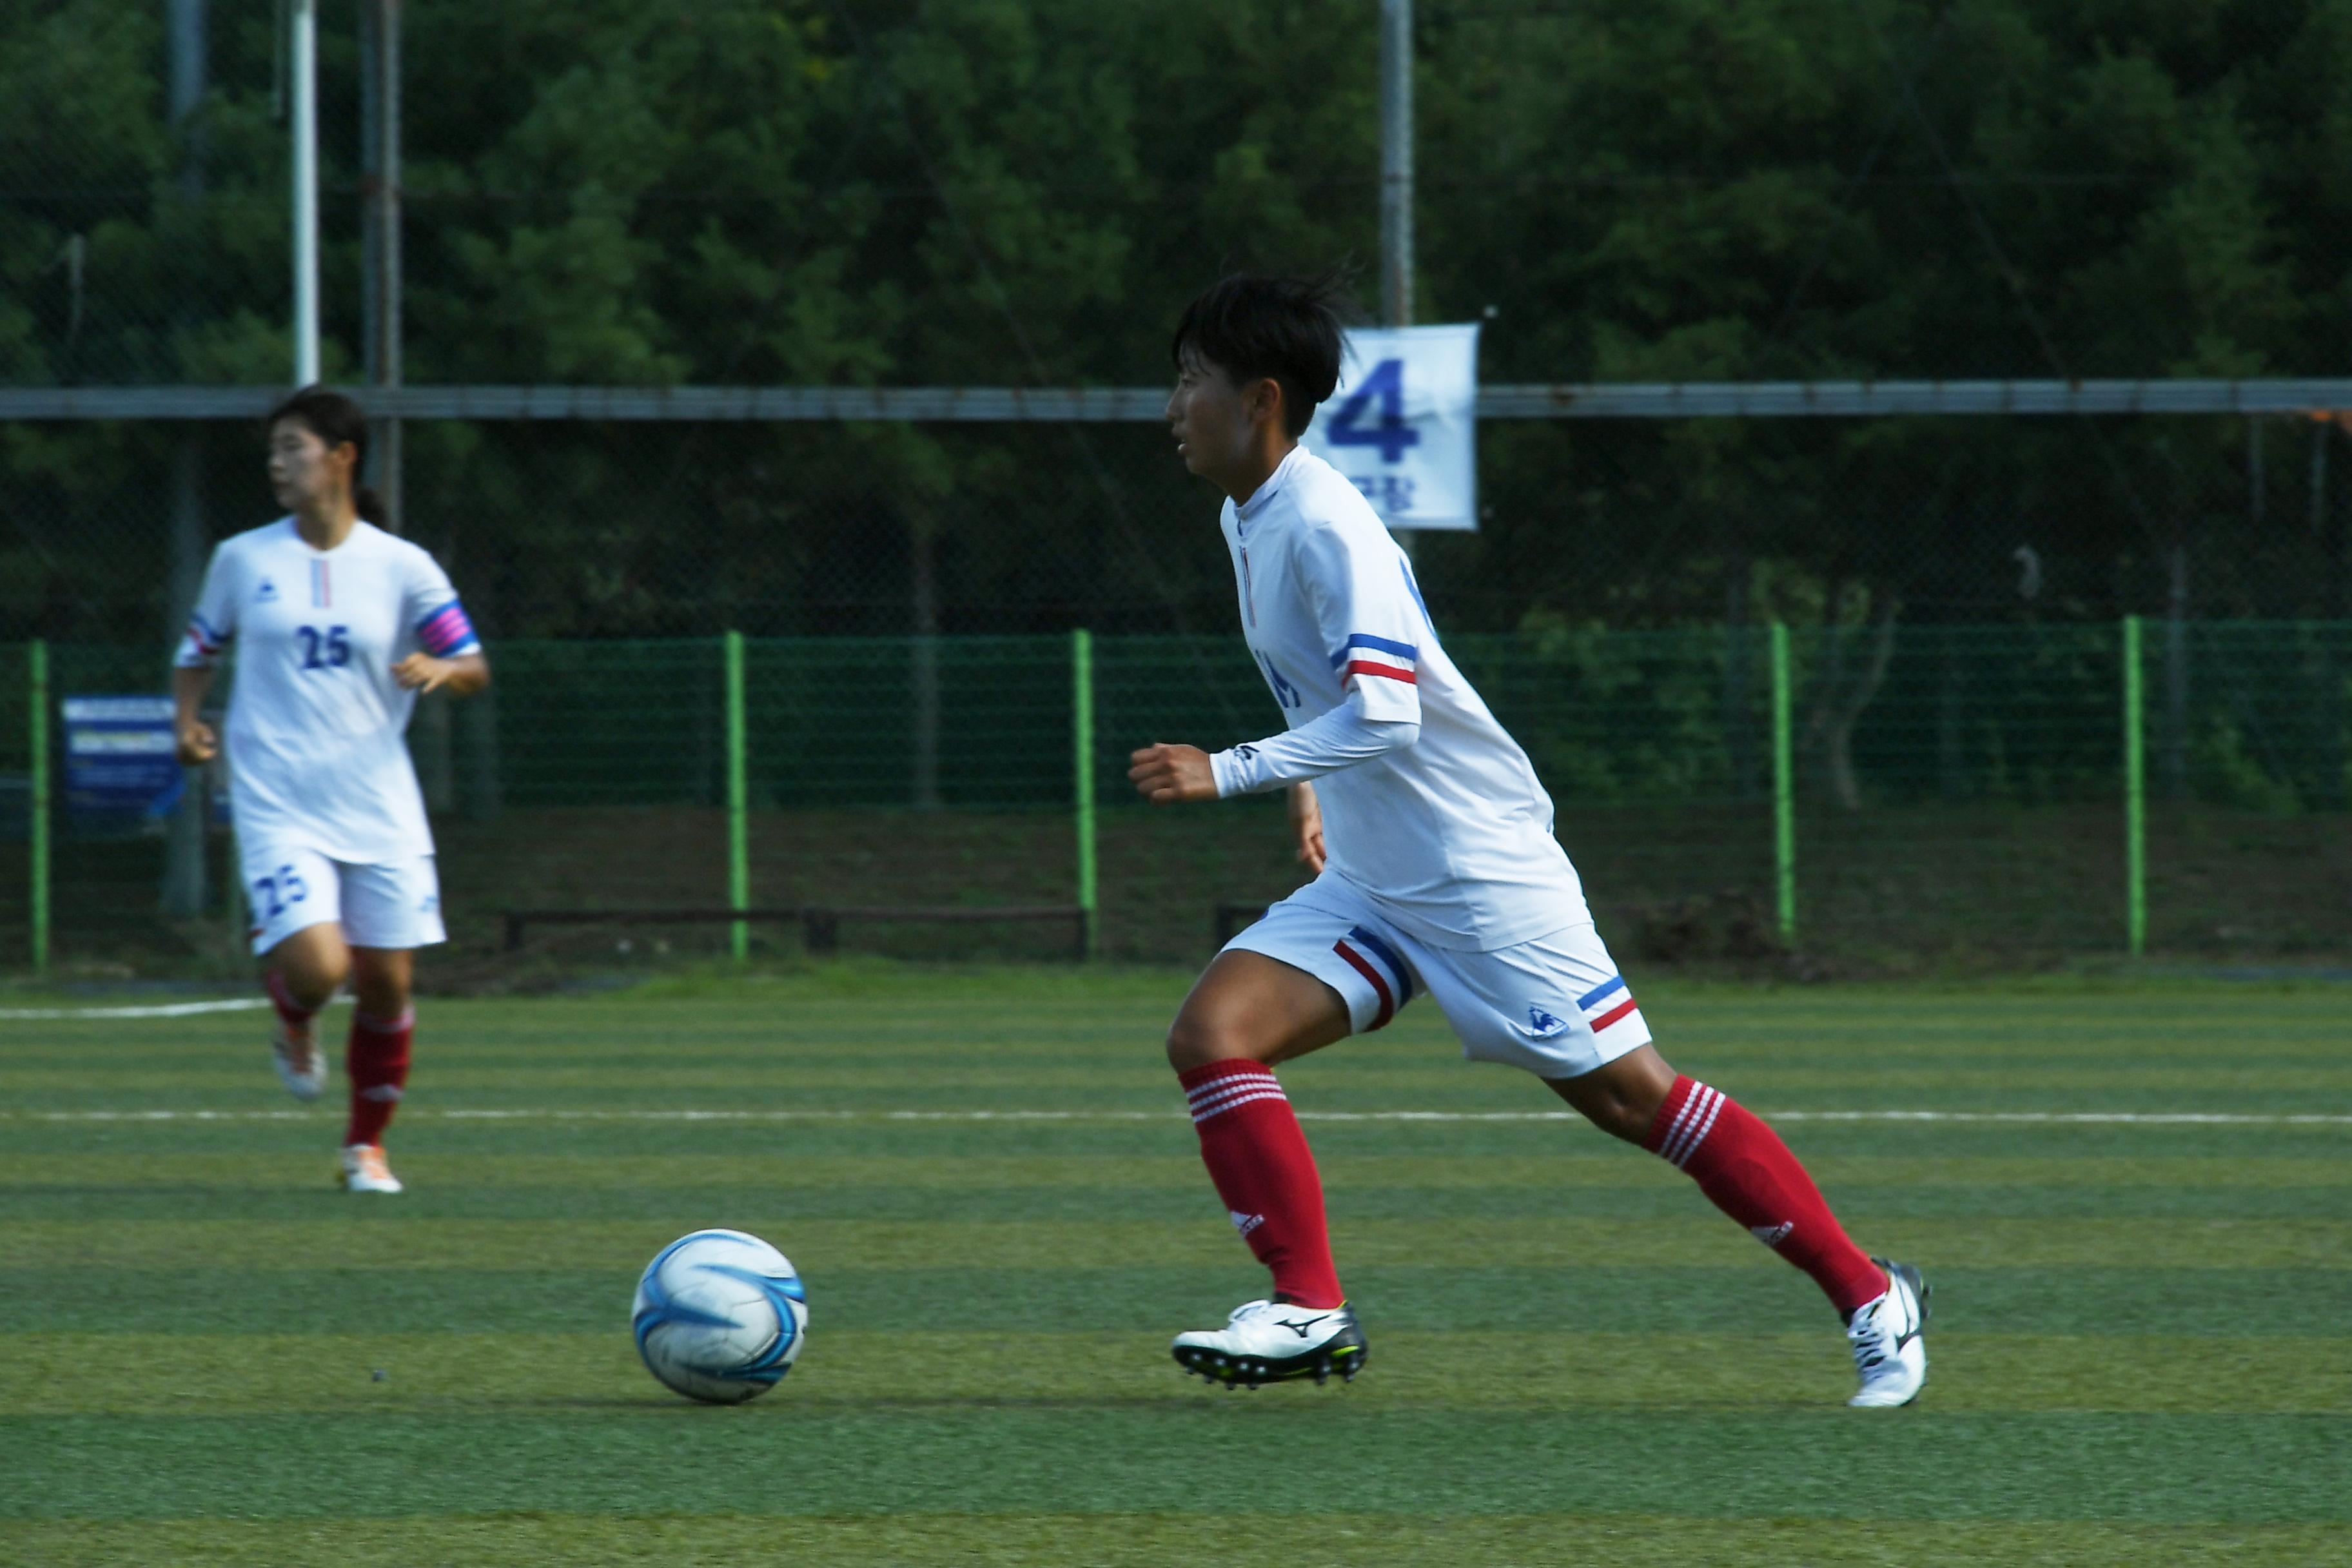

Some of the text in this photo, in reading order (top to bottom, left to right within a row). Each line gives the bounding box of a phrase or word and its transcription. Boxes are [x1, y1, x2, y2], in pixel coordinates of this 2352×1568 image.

[1325, 358, 1420, 464] 4
[297, 625, 351, 669] 25
[255, 864, 307, 918] 25
